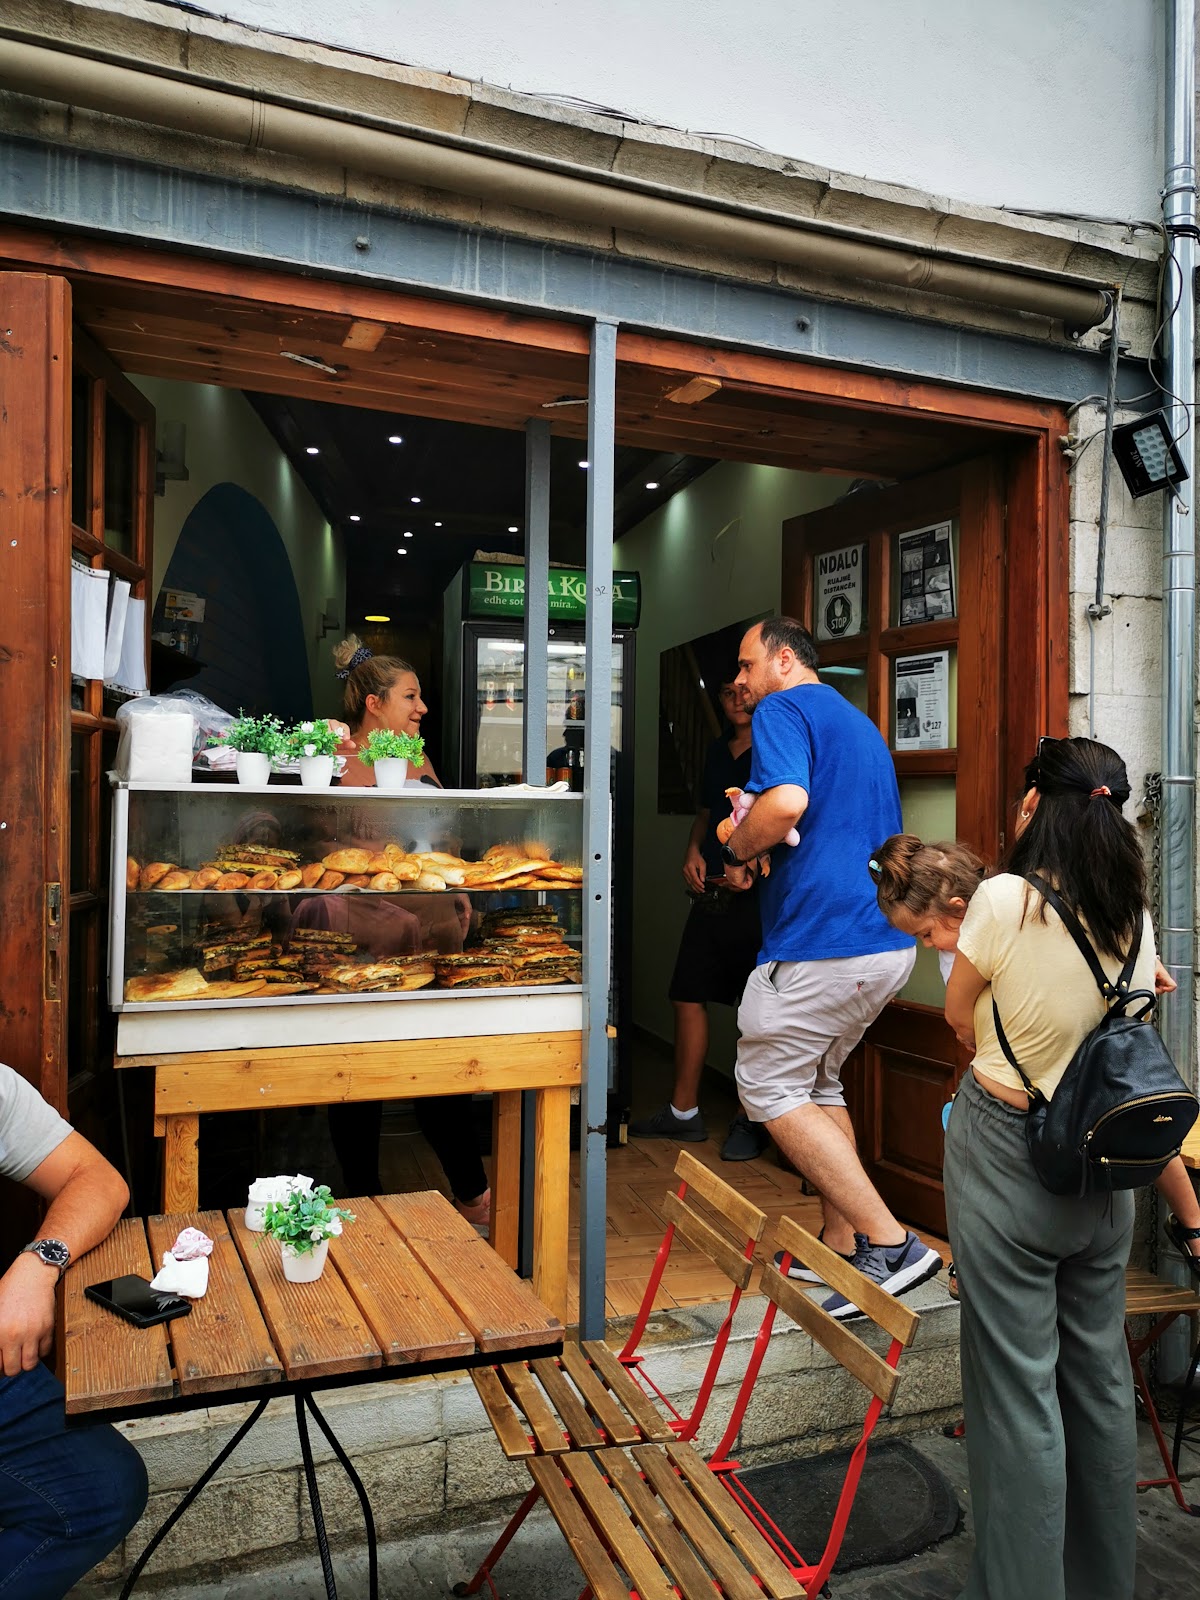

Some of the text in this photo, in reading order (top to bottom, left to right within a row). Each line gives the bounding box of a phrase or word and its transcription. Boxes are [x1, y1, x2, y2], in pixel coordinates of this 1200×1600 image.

[1130, 450, 1143, 468] 20W
[819, 548, 858, 575] NDALO
[484, 571, 624, 605] BIRA KOA
[484, 596, 507, 605] edhe
[831, 617, 847, 630] STOP
[931, 721, 942, 730] 127
